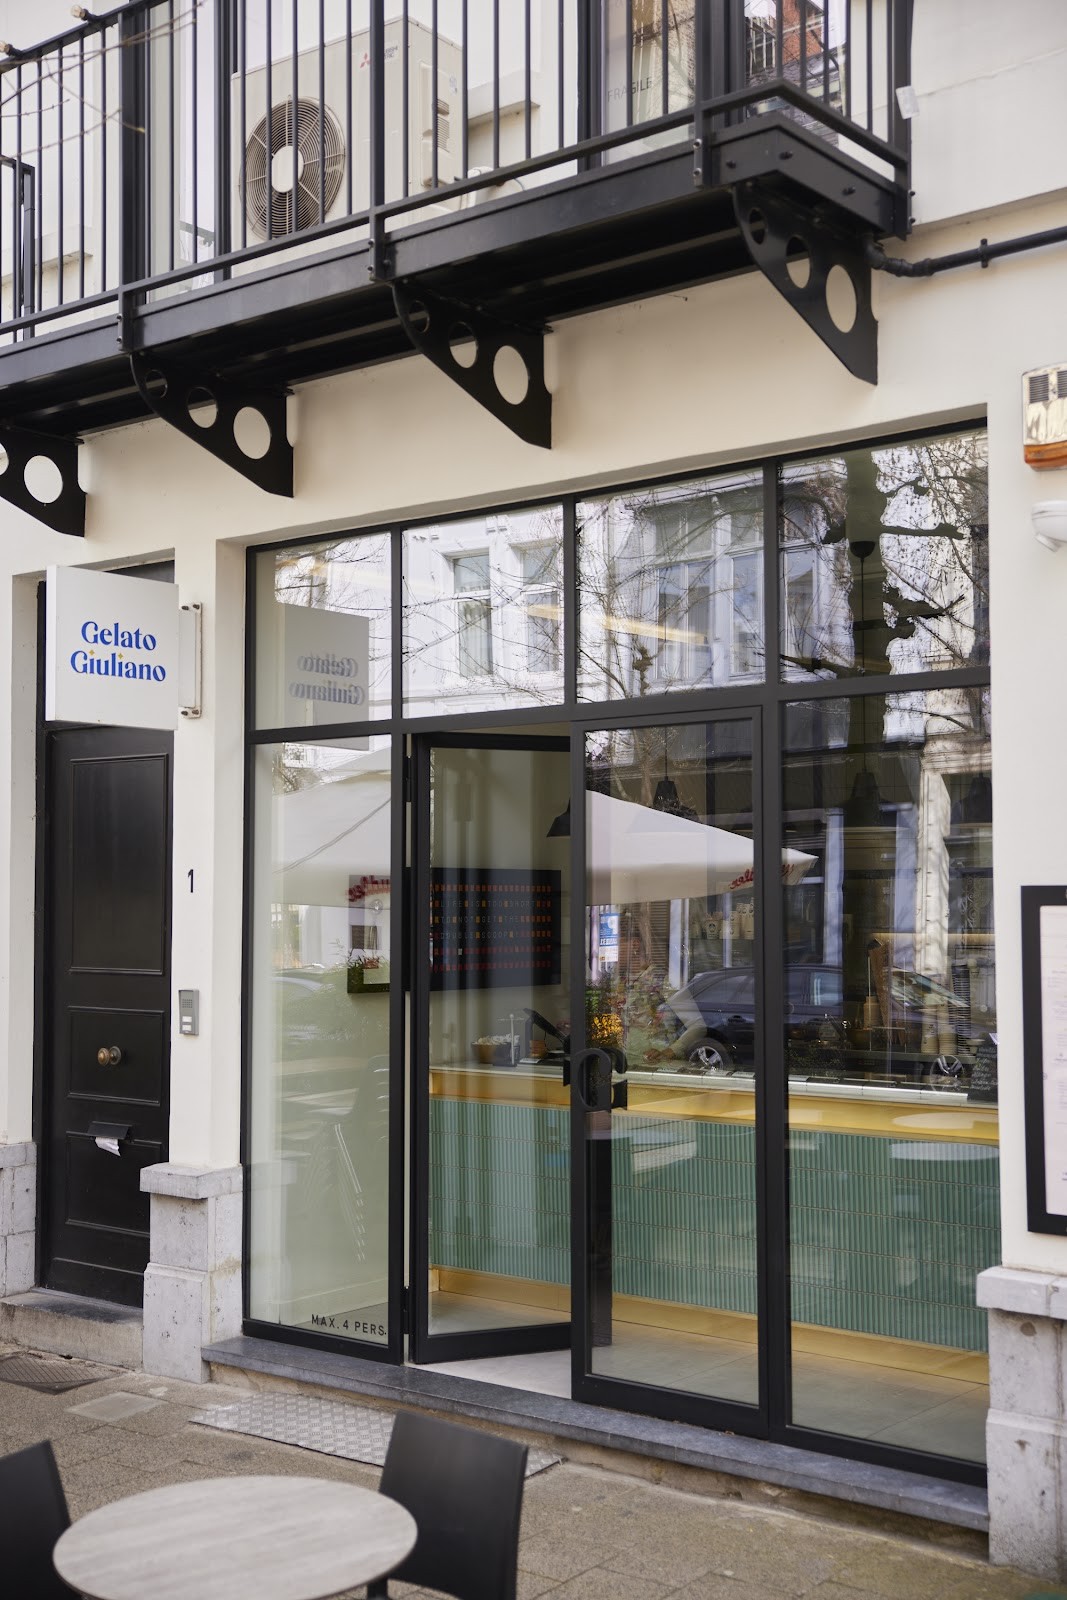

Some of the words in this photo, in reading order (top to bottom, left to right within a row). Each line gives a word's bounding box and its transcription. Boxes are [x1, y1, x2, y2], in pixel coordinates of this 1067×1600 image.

[81, 621, 157, 651] Gelato
[70, 650, 166, 682] Giuliano
[187, 868, 194, 893] 1
[311, 1314, 340, 1329] MAX.
[342, 1319, 349, 1330] 4
[354, 1321, 387, 1336] PERS.
